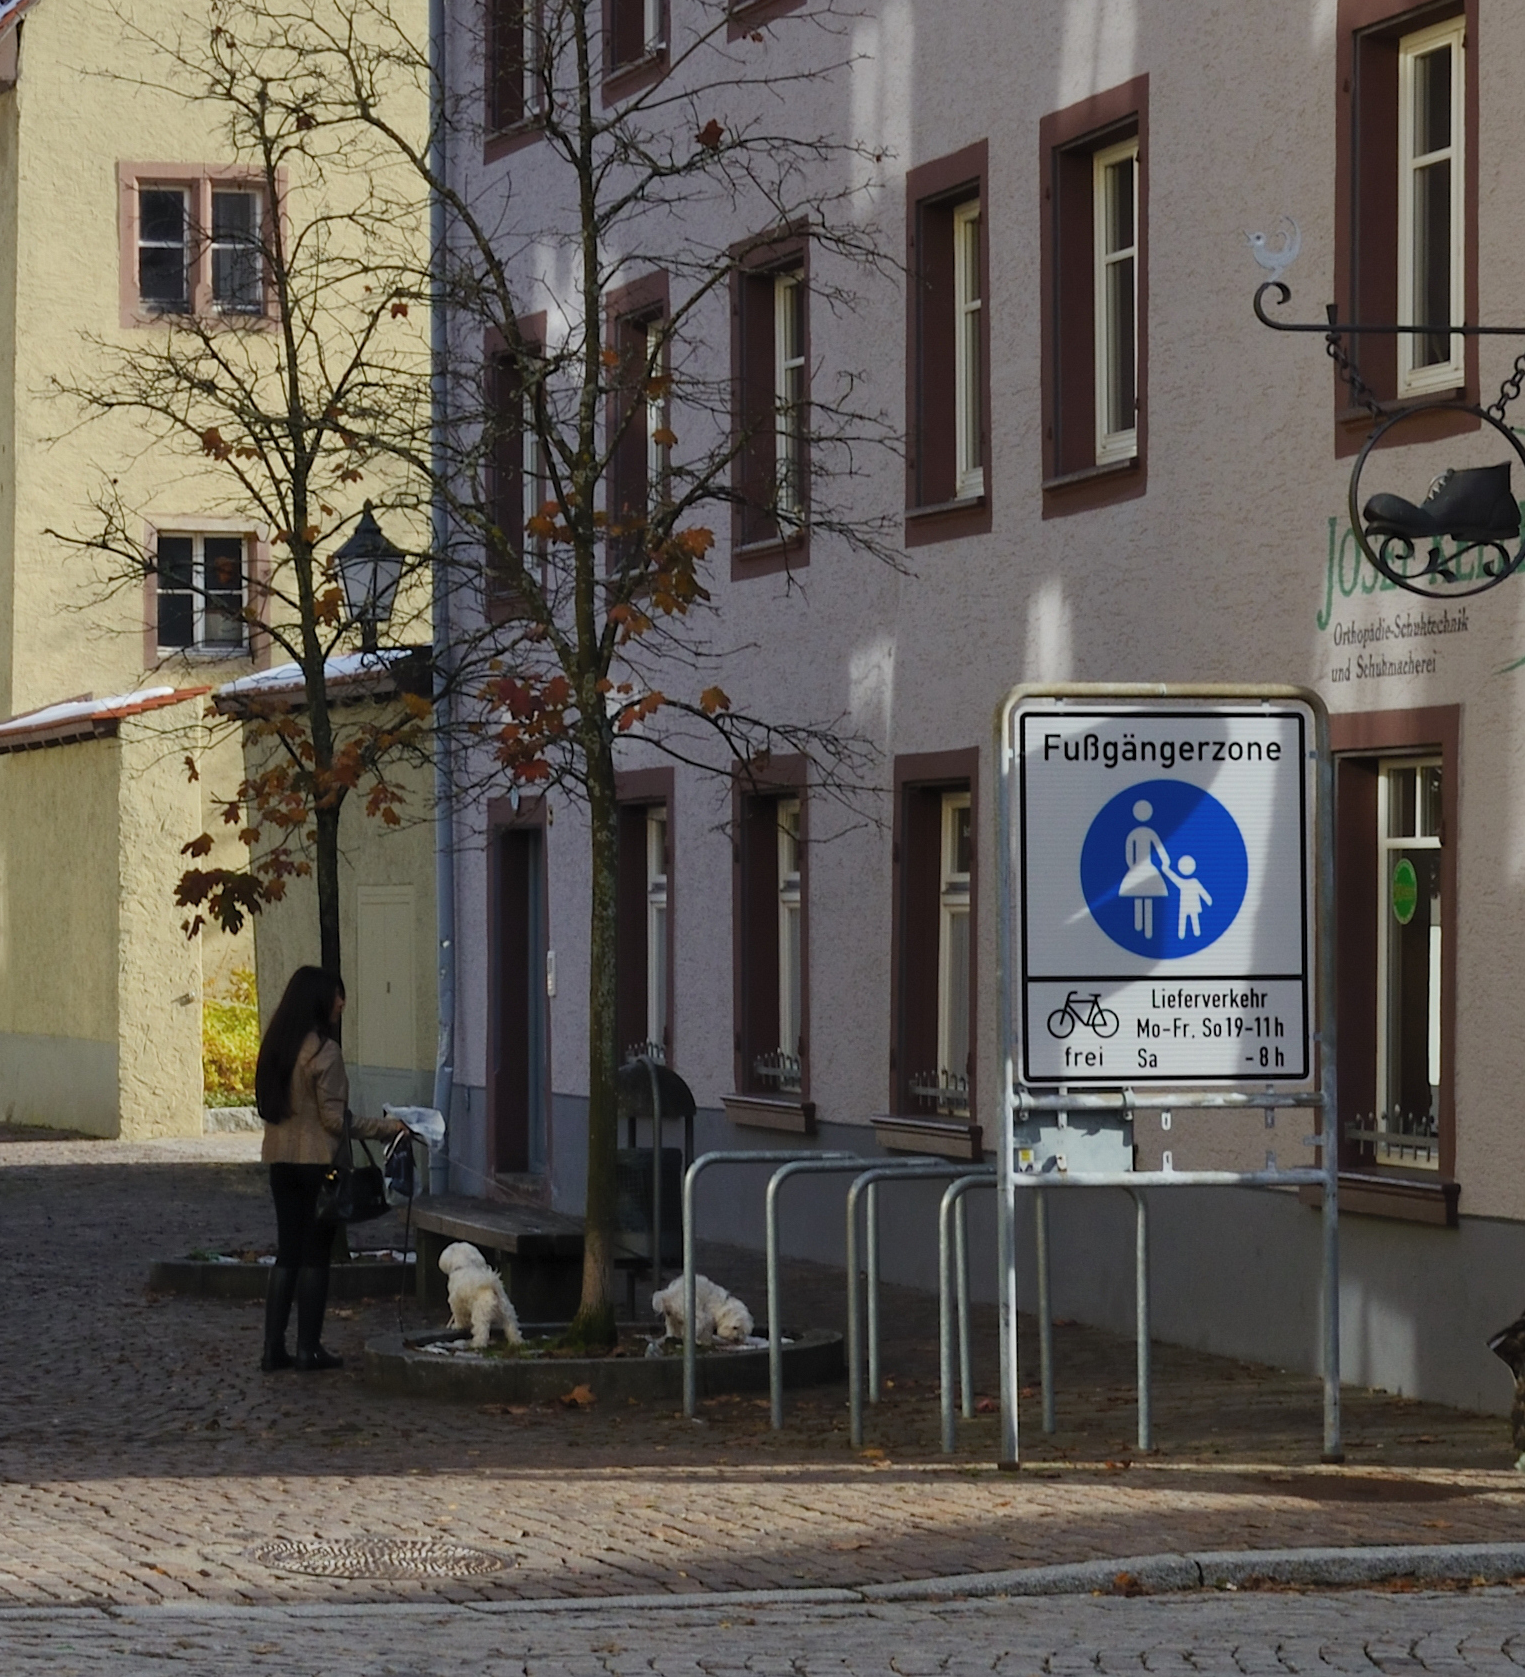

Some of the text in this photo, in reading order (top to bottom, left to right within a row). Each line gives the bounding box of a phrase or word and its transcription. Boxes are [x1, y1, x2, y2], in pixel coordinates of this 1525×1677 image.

[1333, 606, 1470, 649] Orthopädie-Schuhtechnik
[1331, 649, 1437, 683] und Schuhmacherei
[1043, 733, 1283, 769] Fußgängerzone
[1151, 987, 1269, 1009] Lieferverkehr
[1064, 1046, 1104, 1068] frei
[1137, 1047, 1159, 1069] Sa
[1259, 1045, 1270, 1068] 8
[1274, 1045, 1286, 1068] h
